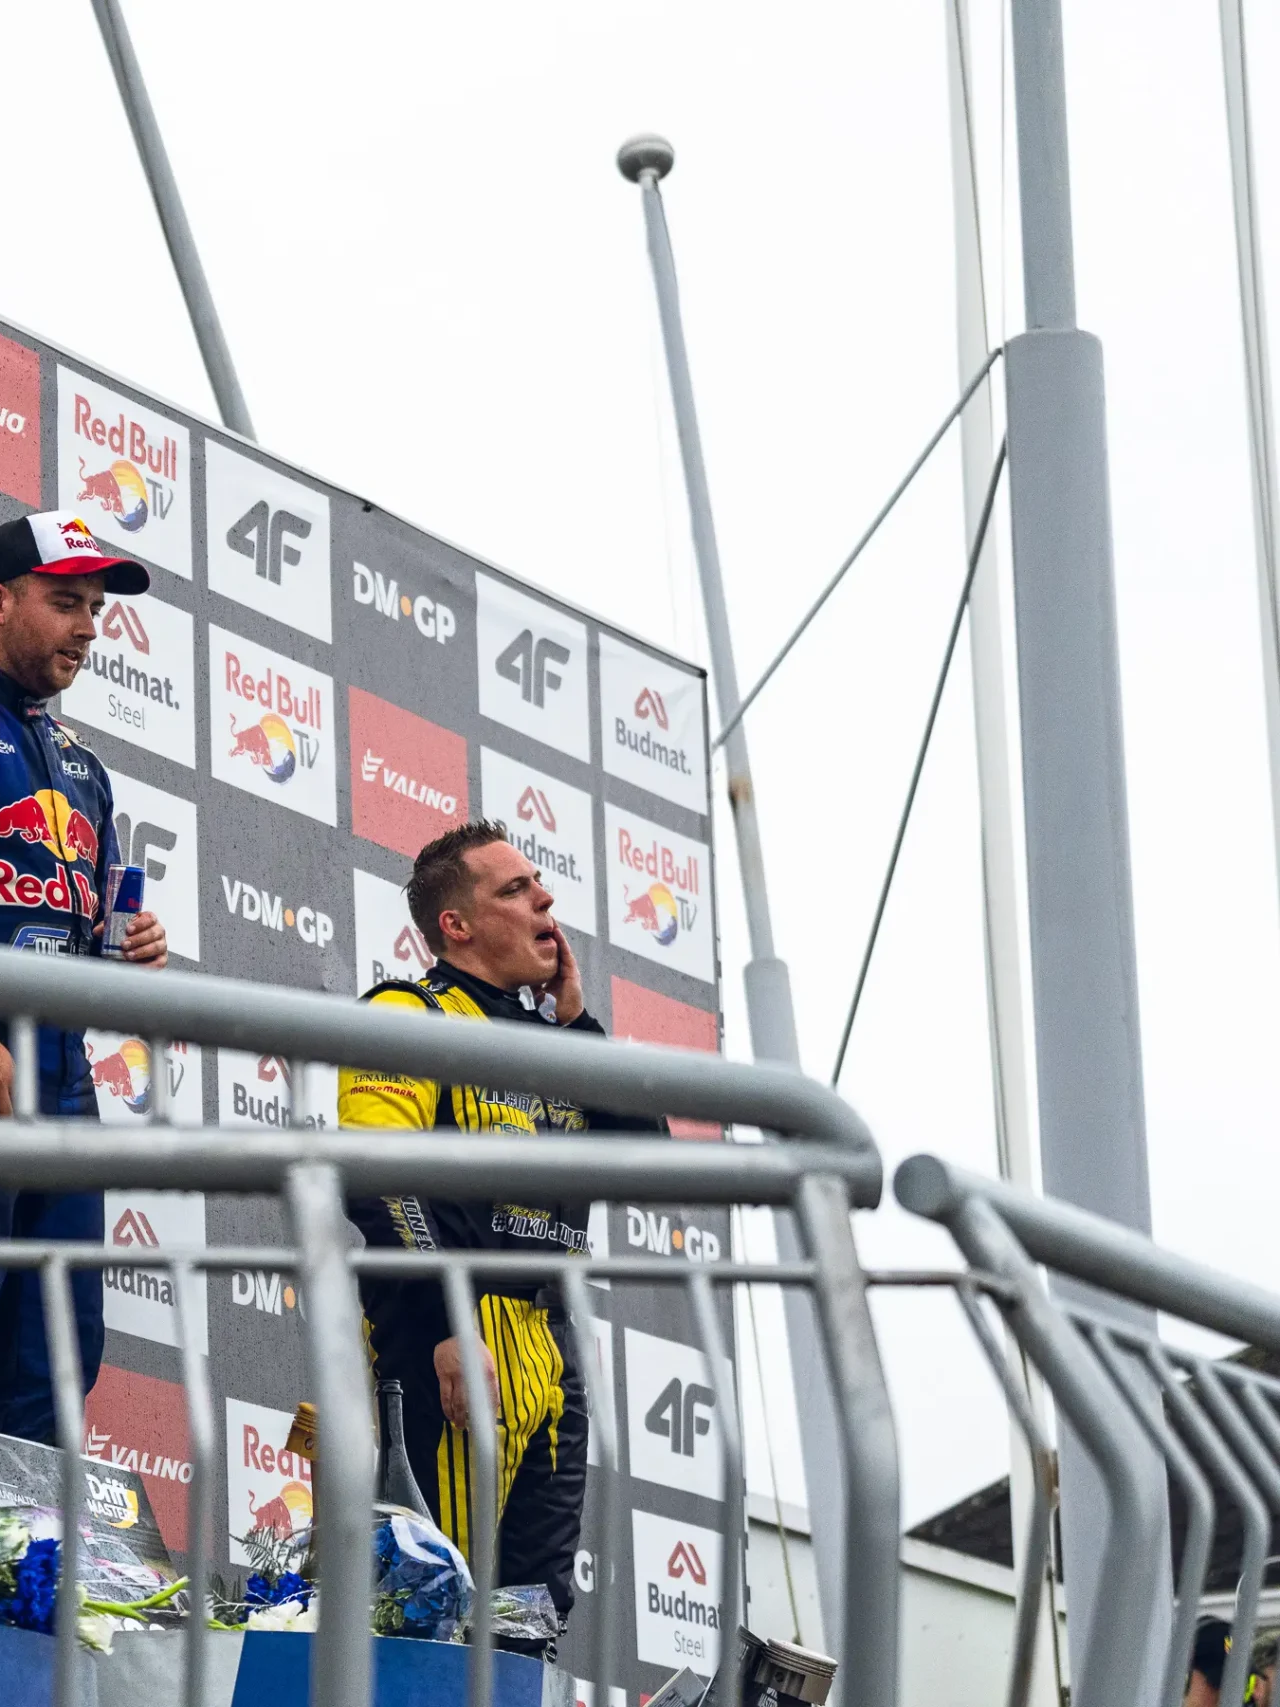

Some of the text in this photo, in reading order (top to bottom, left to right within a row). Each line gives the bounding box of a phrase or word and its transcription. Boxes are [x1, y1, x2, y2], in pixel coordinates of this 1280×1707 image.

[74, 393, 177, 481] Red Bull
[146, 477, 174, 521] TV
[65, 537, 93, 550] Red
[226, 500, 312, 586] 4F
[226, 651, 321, 729] Red Bull
[495, 629, 571, 709] 4F
[108, 694, 145, 730] Steel
[293, 729, 319, 769] TV
[615, 718, 692, 775] Budmat.
[383, 768, 457, 816] VALINO
[618, 827, 699, 895] Red Bull
[645, 1377, 716, 1458] 4F
[647, 1582, 720, 1629] Budma
[673, 1630, 706, 1659] Steel
